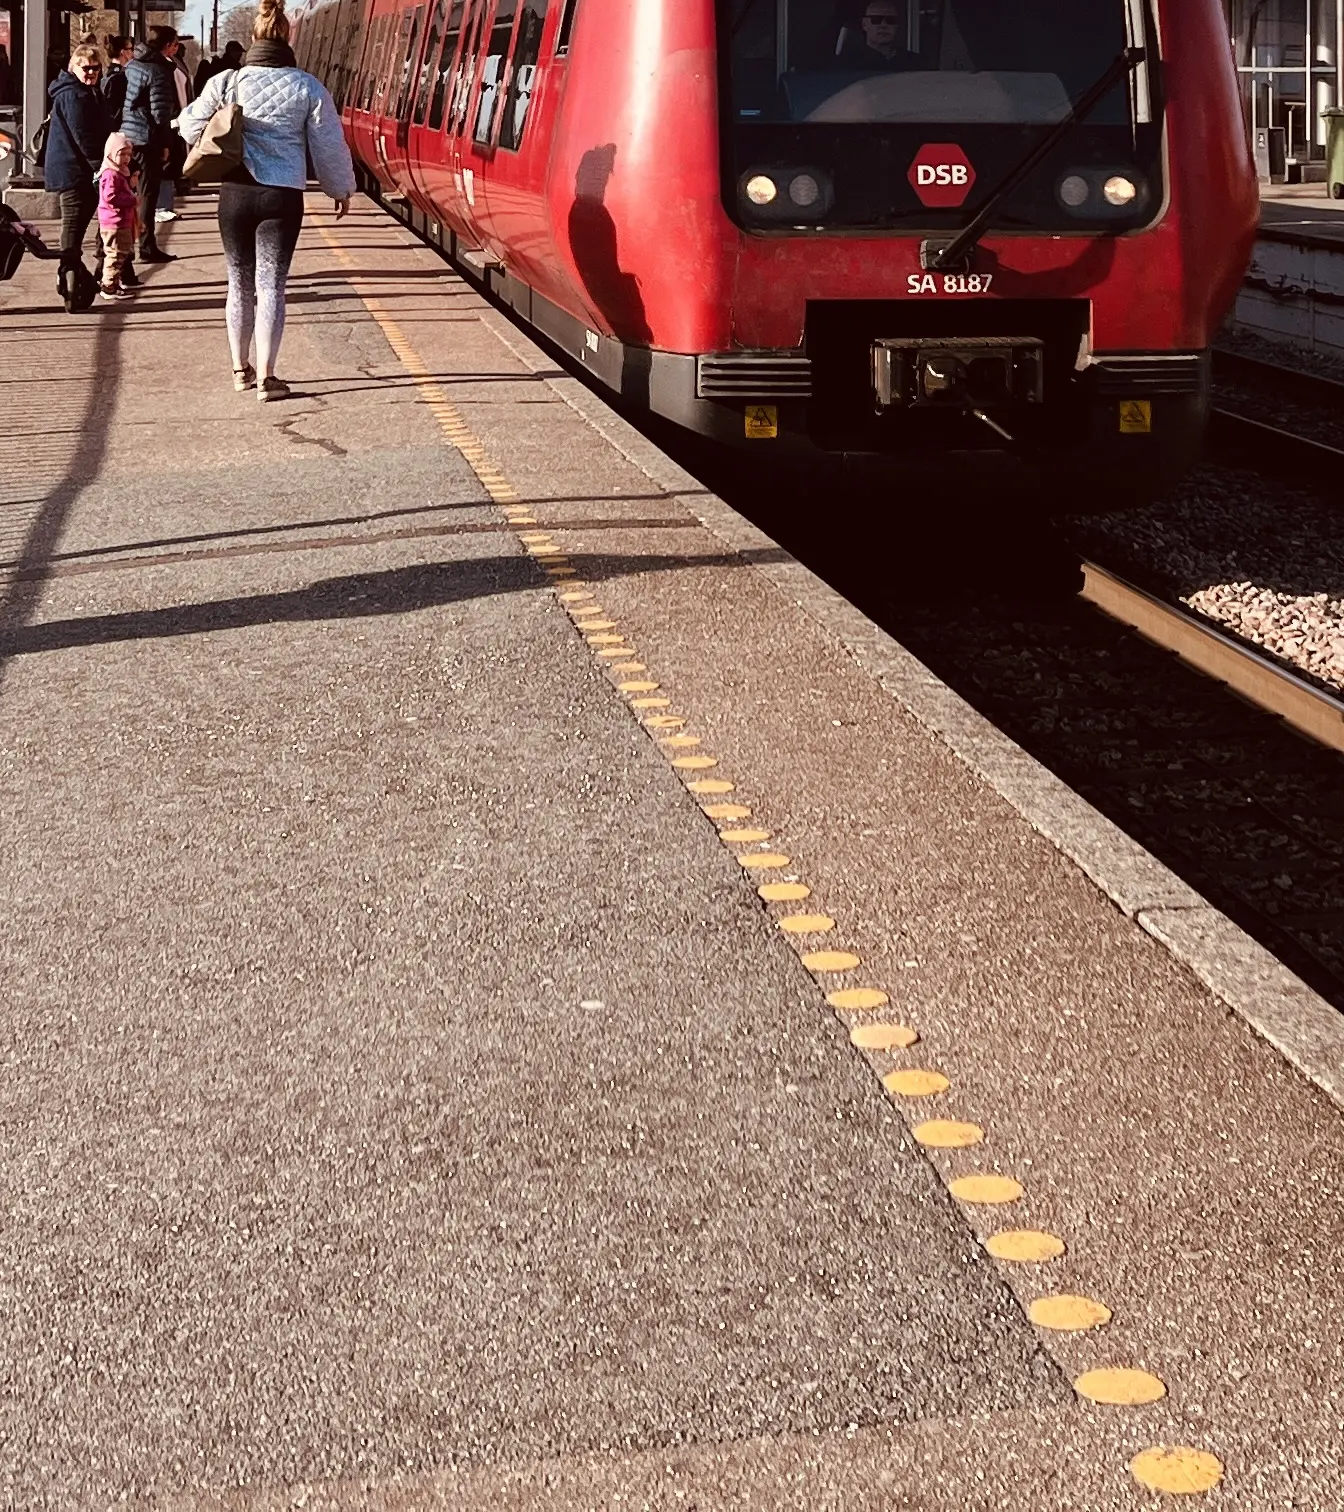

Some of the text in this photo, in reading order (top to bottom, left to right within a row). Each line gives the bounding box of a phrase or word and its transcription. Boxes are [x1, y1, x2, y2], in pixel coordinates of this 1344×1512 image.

[917, 165, 968, 185] DSB
[907, 273, 993, 294] SA 8187
